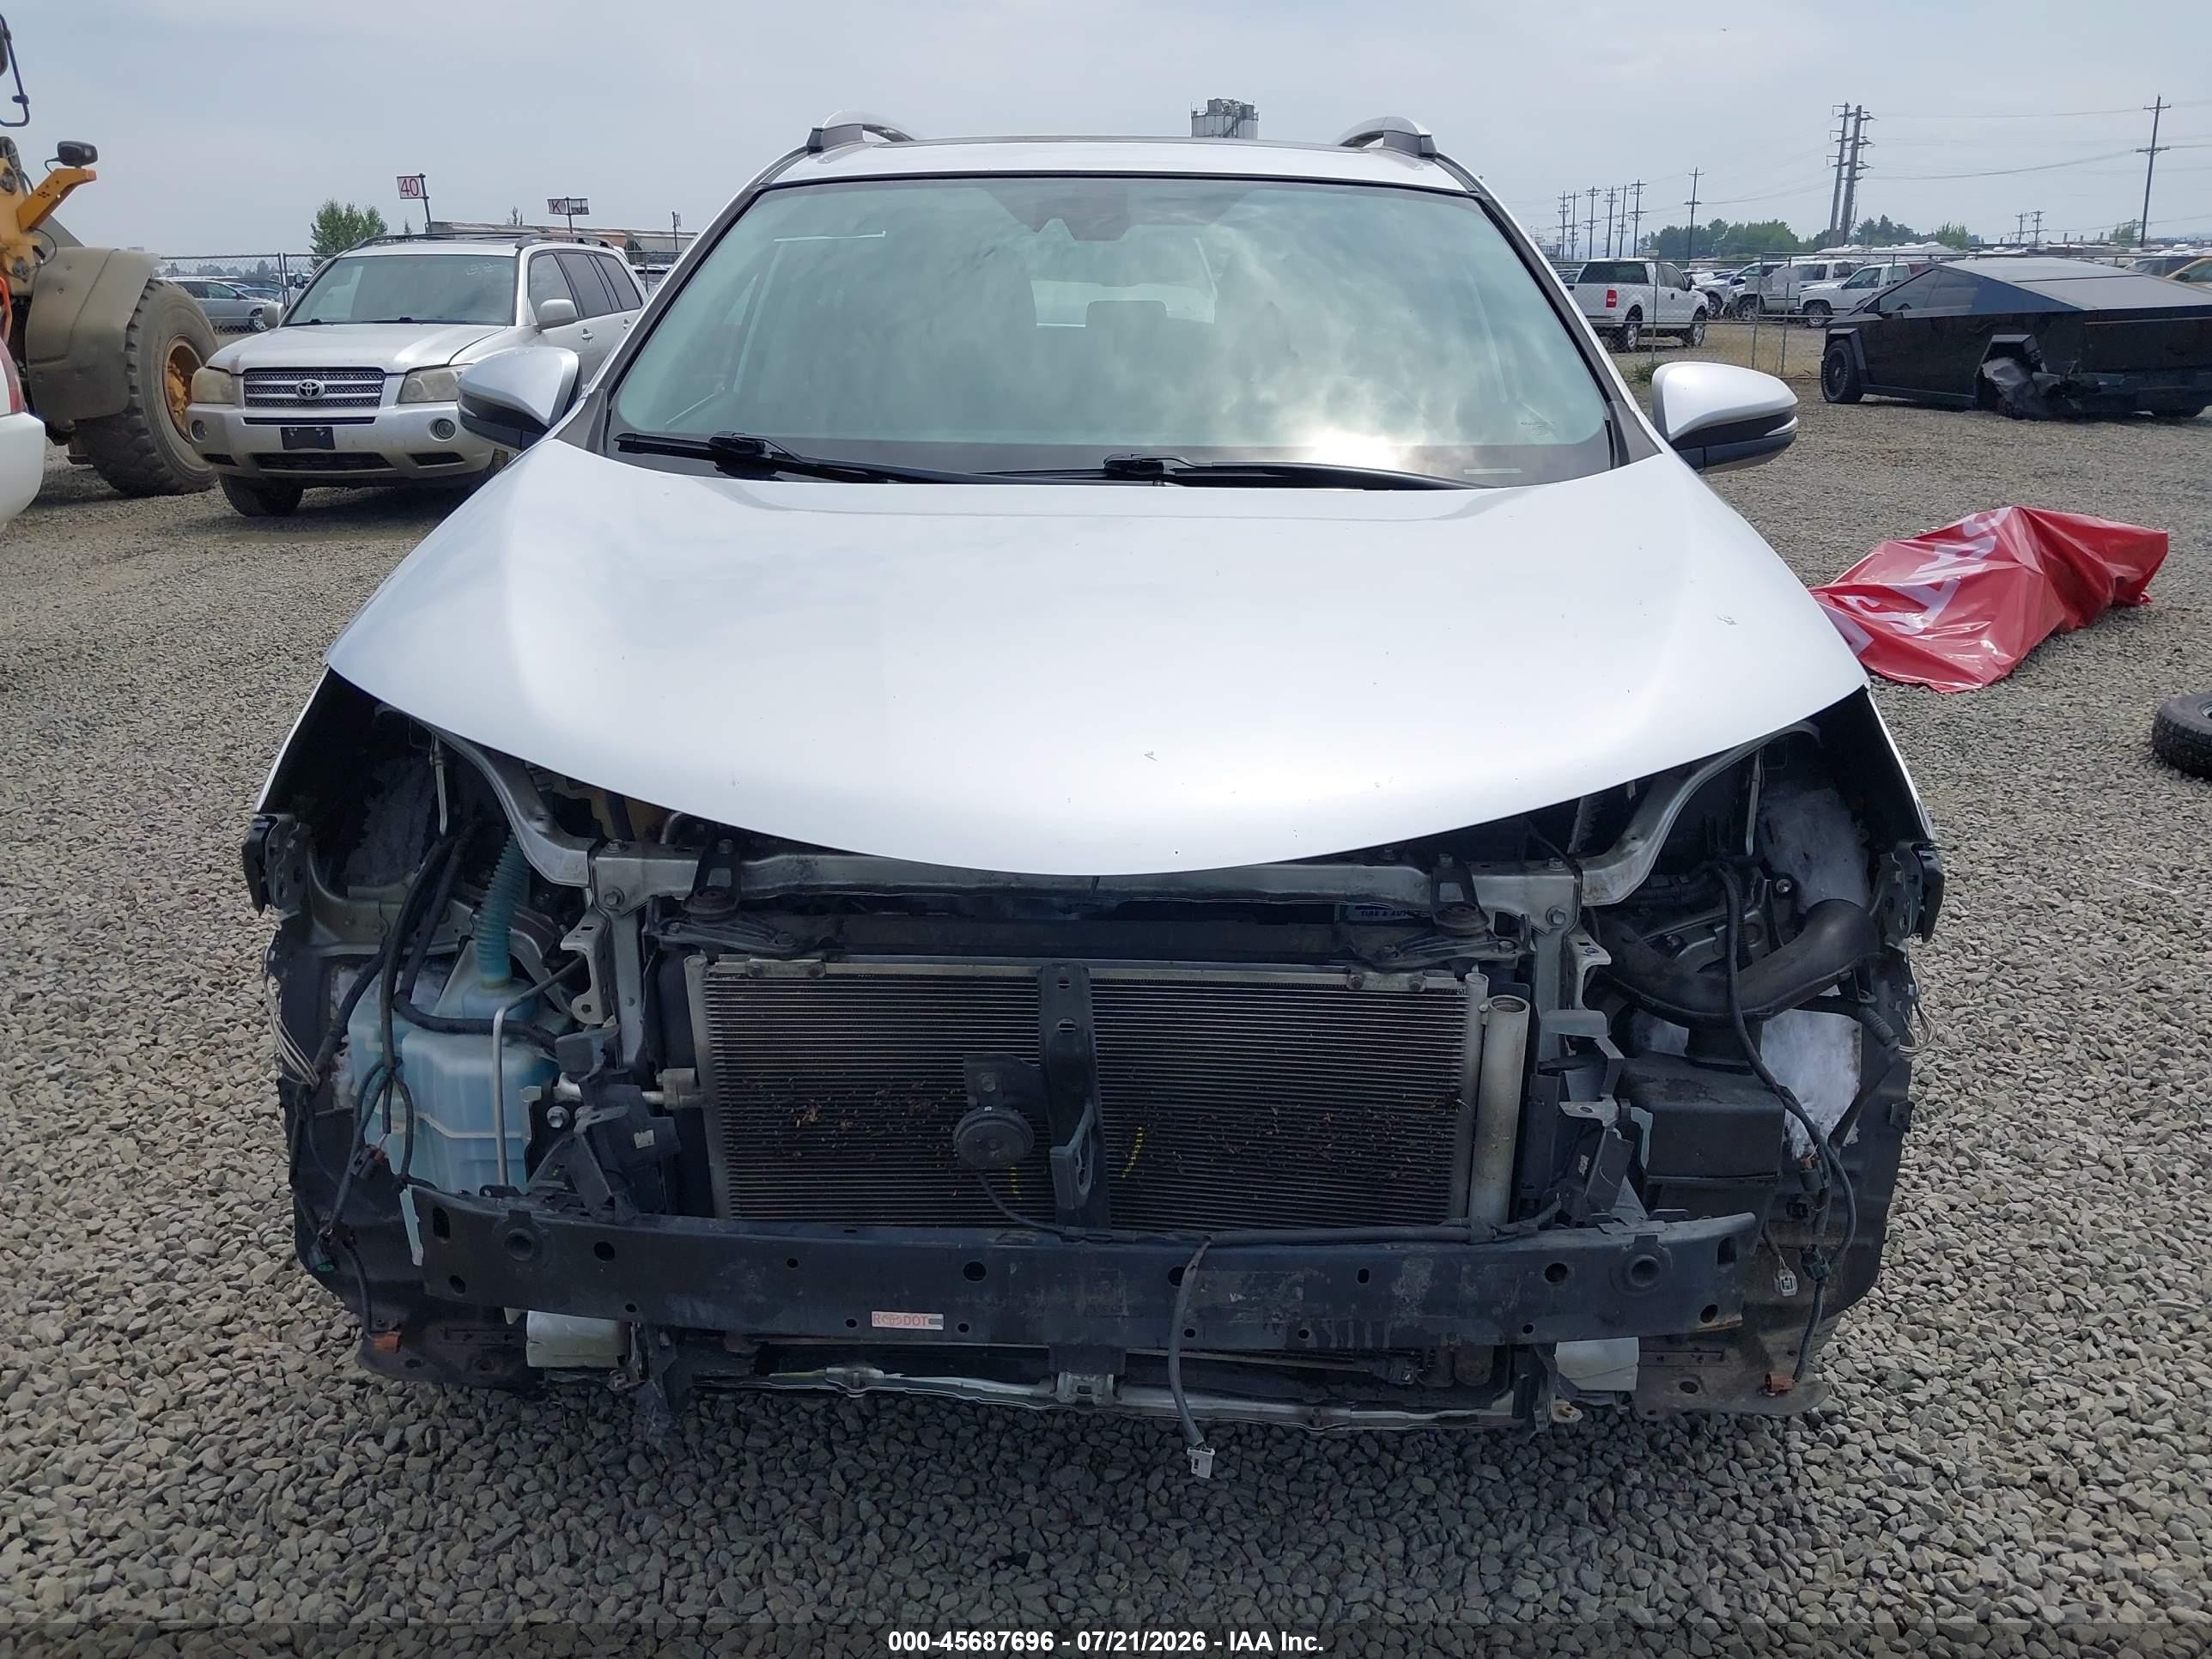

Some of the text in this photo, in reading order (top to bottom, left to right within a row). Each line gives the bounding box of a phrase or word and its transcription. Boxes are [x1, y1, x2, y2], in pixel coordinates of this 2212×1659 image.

[400, 178, 419, 197] 40
[552, 199, 561, 213] K
[576, 199, 584, 213] J
